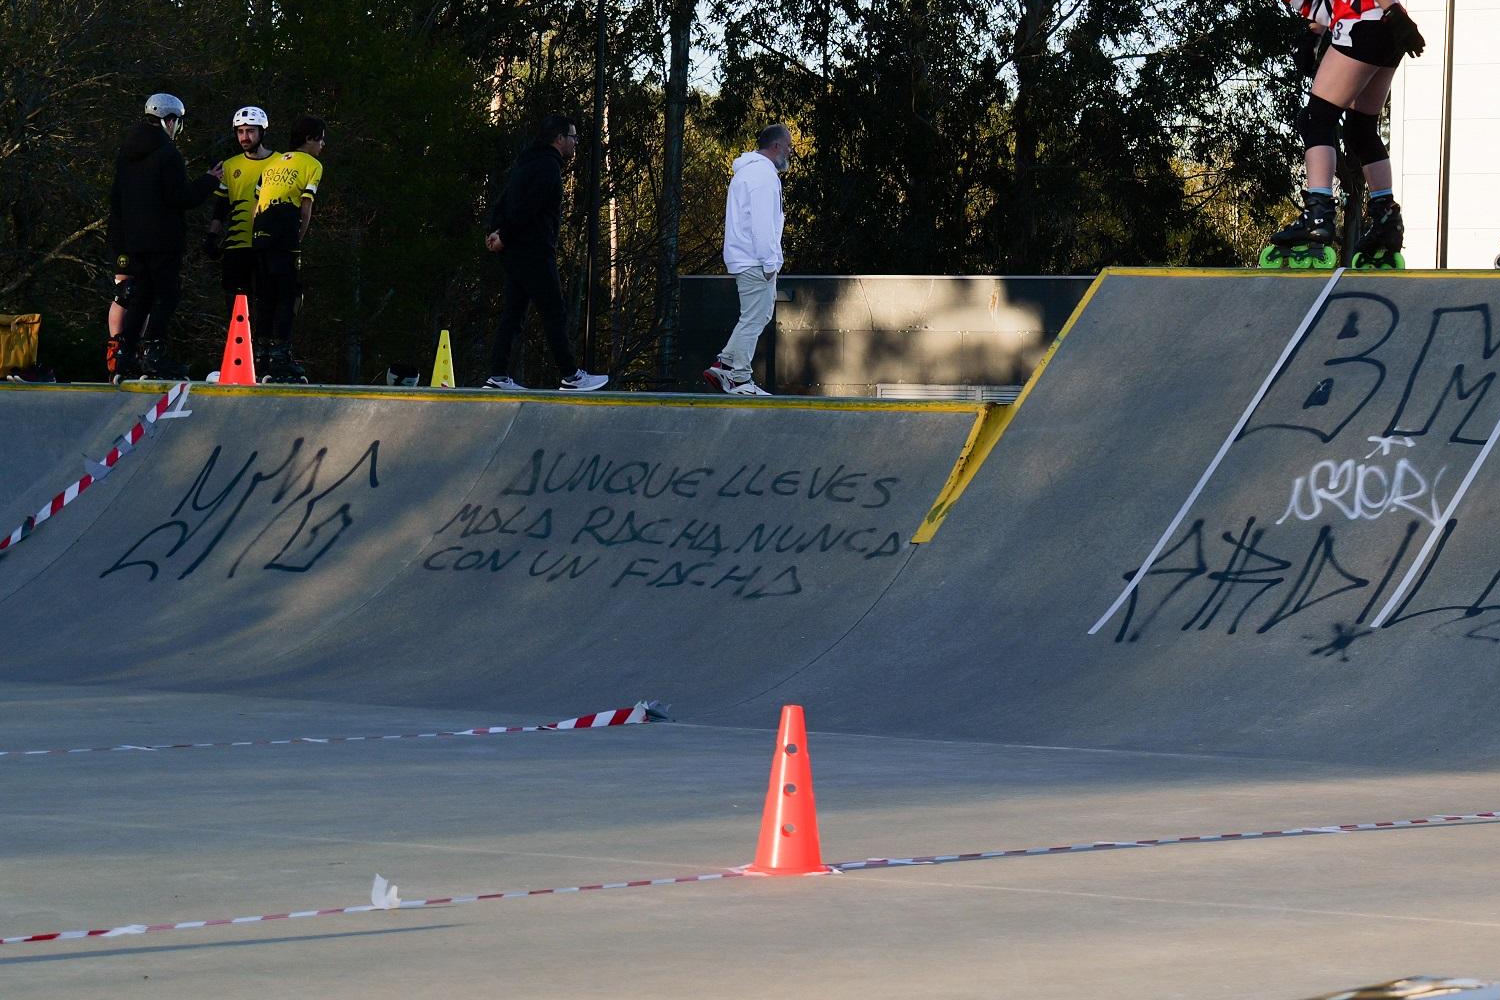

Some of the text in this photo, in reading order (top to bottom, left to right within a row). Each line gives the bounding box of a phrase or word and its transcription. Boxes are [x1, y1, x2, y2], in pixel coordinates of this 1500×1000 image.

[502, 448, 904, 508] AUNQUE LLEVES
[435, 503, 900, 560] MALA RACHA NUNCA
[423, 546, 803, 599] CON UN FACHA
